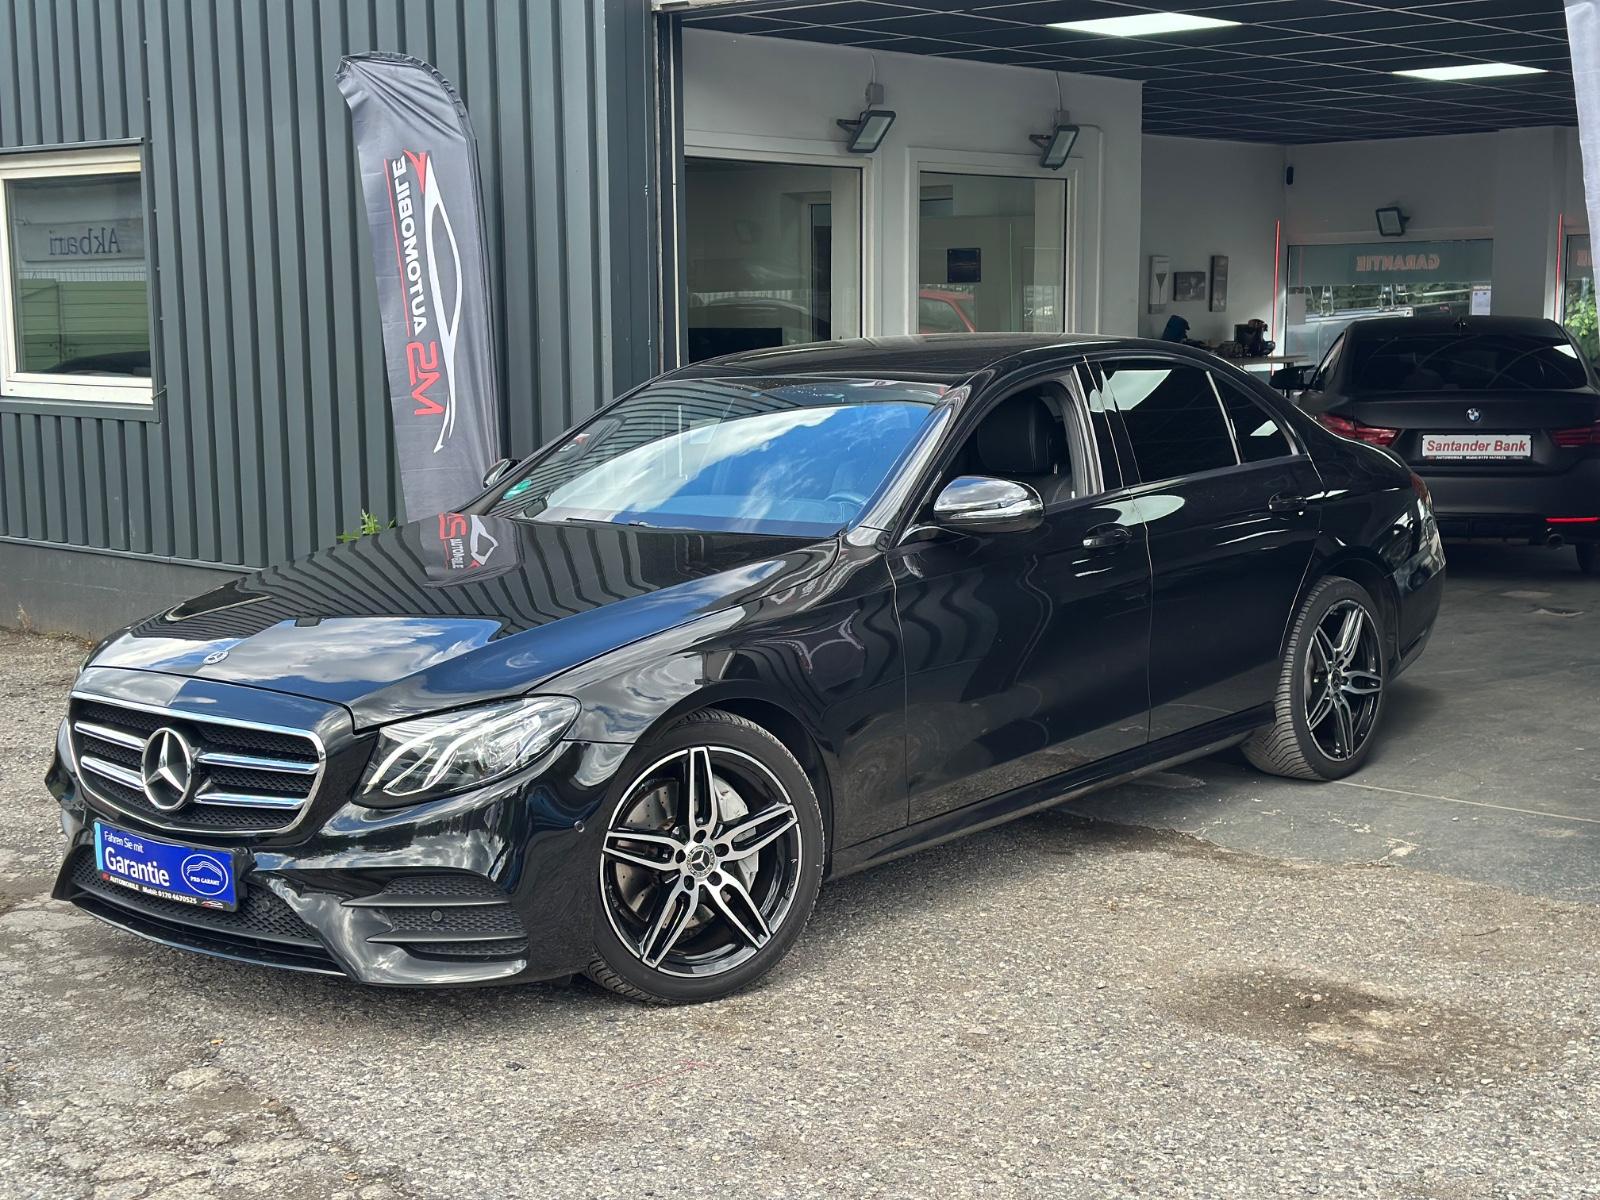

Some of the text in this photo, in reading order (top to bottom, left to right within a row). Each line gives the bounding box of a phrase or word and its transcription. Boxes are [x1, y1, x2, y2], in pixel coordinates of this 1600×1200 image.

[1426, 440, 1526, 452] Santander Bank
[104, 831, 144, 854] Fahren Sie mit
[105, 846, 171, 887] Garantie
